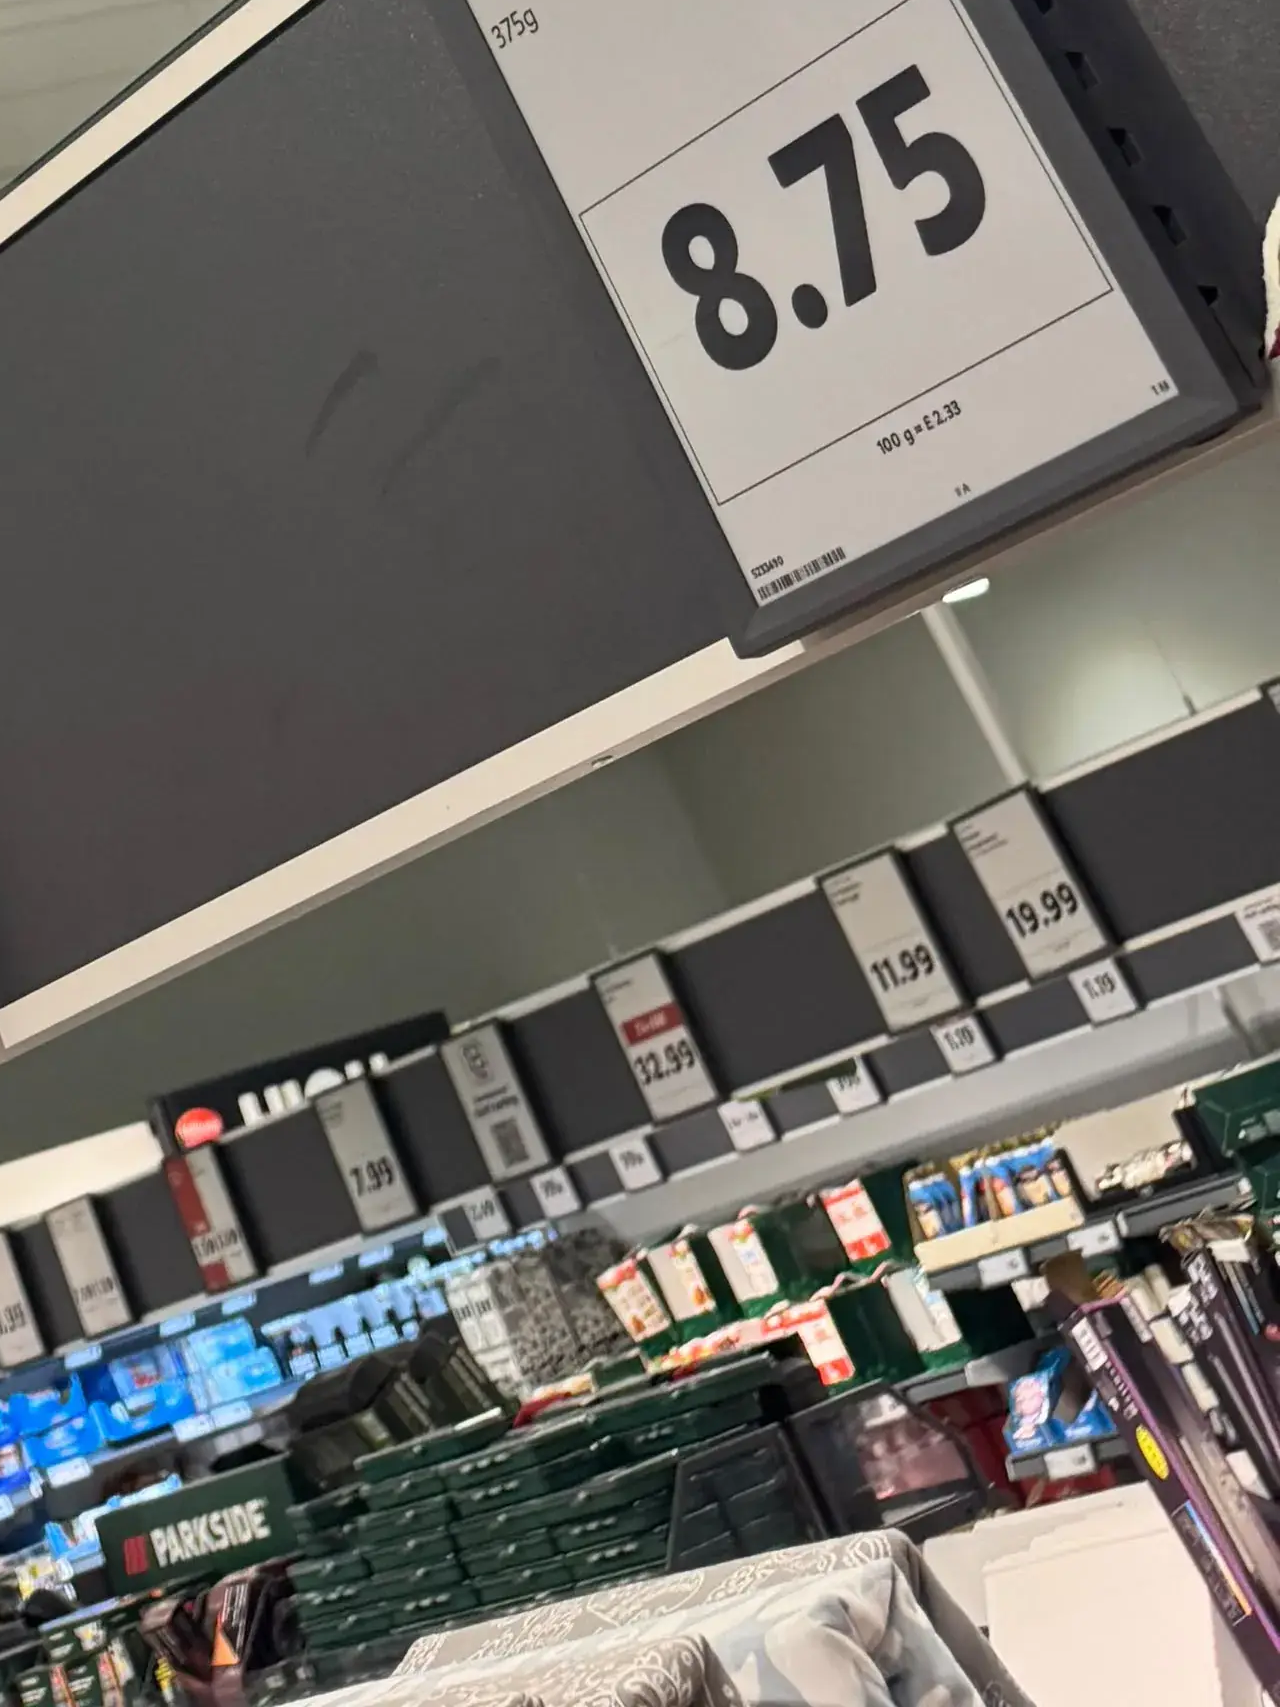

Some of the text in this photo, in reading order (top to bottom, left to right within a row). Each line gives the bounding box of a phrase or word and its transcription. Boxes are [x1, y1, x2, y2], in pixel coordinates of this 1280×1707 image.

[490, 6, 540, 50] 375g
[660, 62, 987, 372] 8.75
[876, 432, 901, 455] 100
[1005, 880, 1079, 940] 19.99
[870, 943, 936, 993] 11.99
[148, 1496, 273, 1569] PARKSIDE
